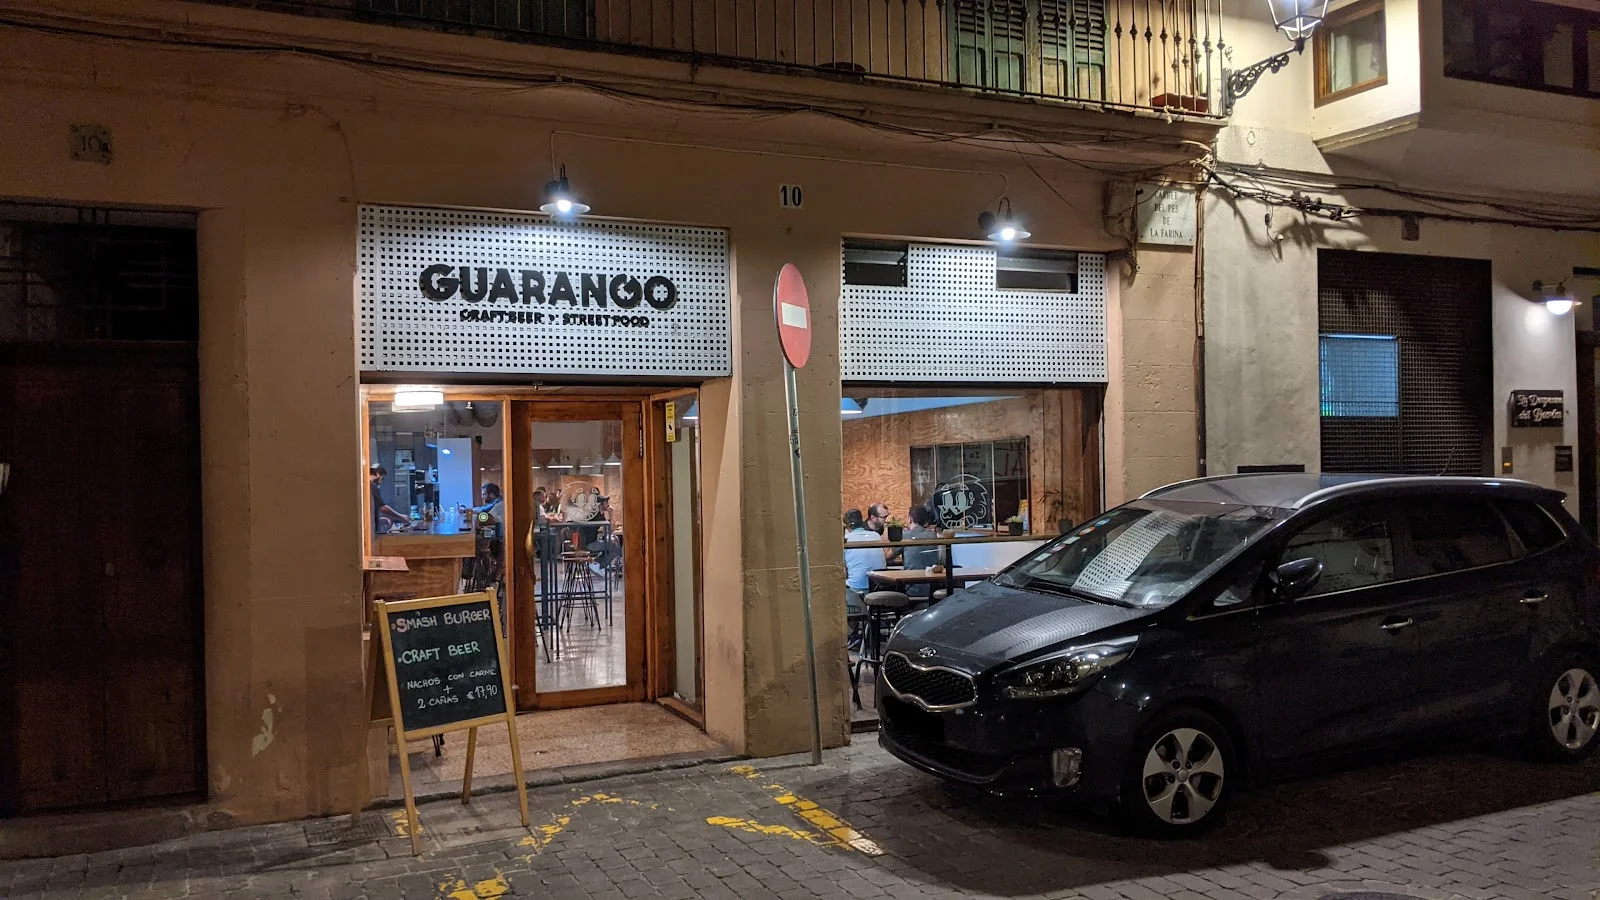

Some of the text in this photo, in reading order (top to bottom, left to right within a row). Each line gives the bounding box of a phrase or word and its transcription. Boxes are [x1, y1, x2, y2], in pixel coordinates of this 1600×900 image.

[780, 185, 802, 206] 10
[1154, 203, 1179, 213] DEL PES
[1162, 216, 1171, 226] DE
[1150, 228, 1183, 239] LA FARINA
[419, 263, 678, 310] GUARANGO
[396, 608, 491, 633] SMASH BURGER
[401, 640, 481, 664] CRAFT BEER
[407, 669, 497, 690] NACHOS CON CARNE
[417, 698, 426, 709] 2
[428, 695, 459, 706] CAÑAS
